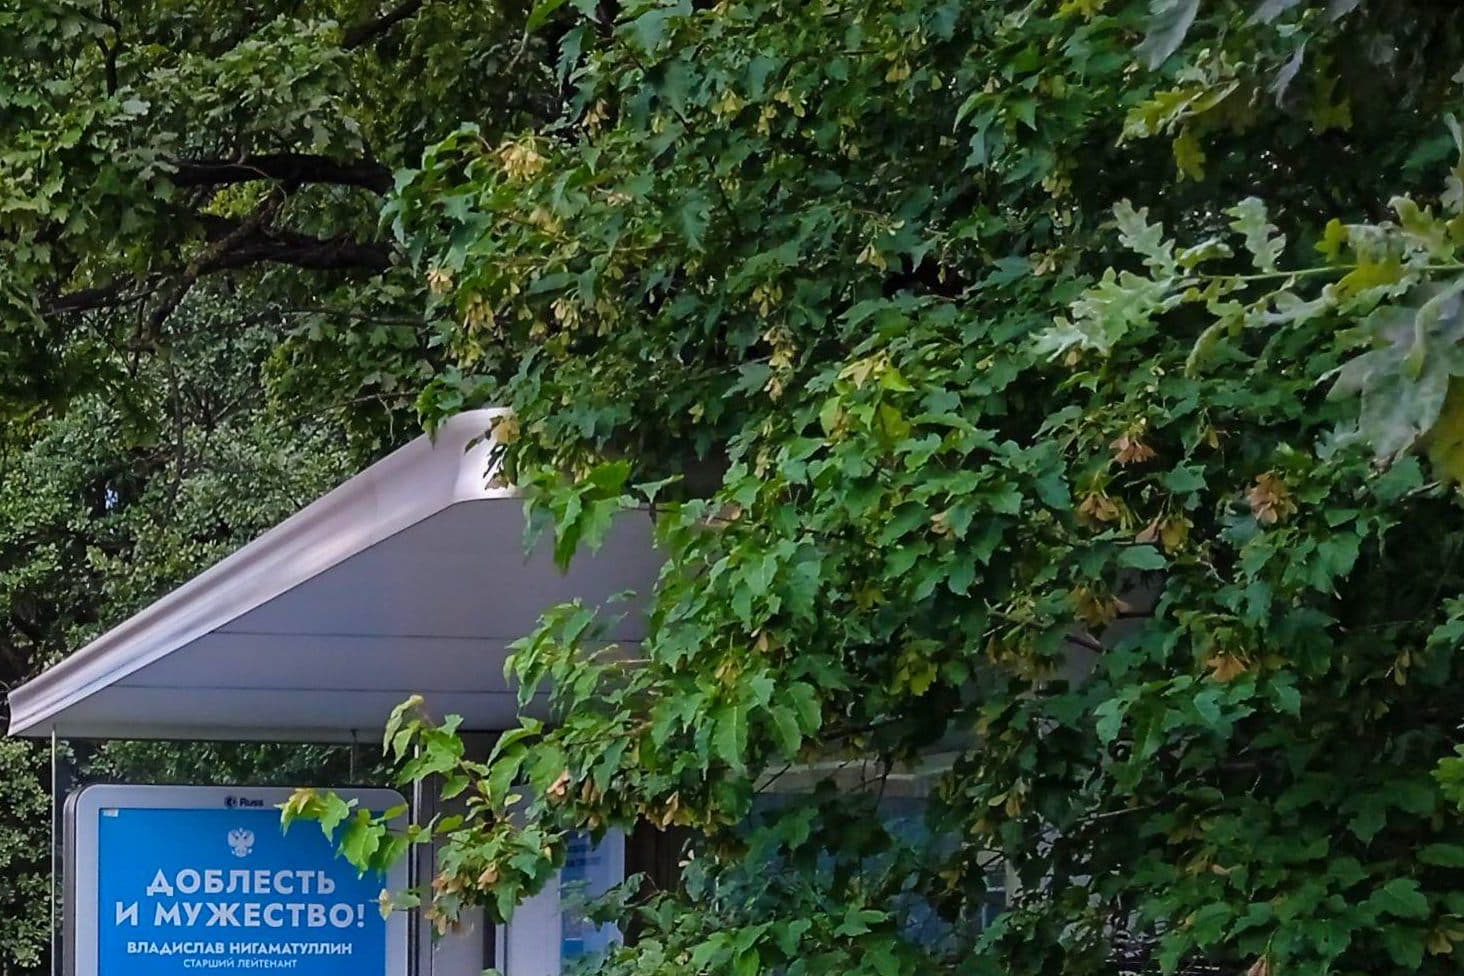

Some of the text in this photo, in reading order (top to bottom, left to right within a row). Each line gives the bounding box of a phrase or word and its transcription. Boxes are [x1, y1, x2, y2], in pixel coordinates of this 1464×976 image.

[146, 868, 336, 897] ДОБЛЕСТЬ
[115, 901, 366, 929] И МУЖЕСТВО!
[127, 941, 353, 956] ВЛАДИСЛАВ НИГАМАТУЛЛИН
[183, 957, 298, 969] СТАРШИЙ ЛЕЙТЕНАНТ
